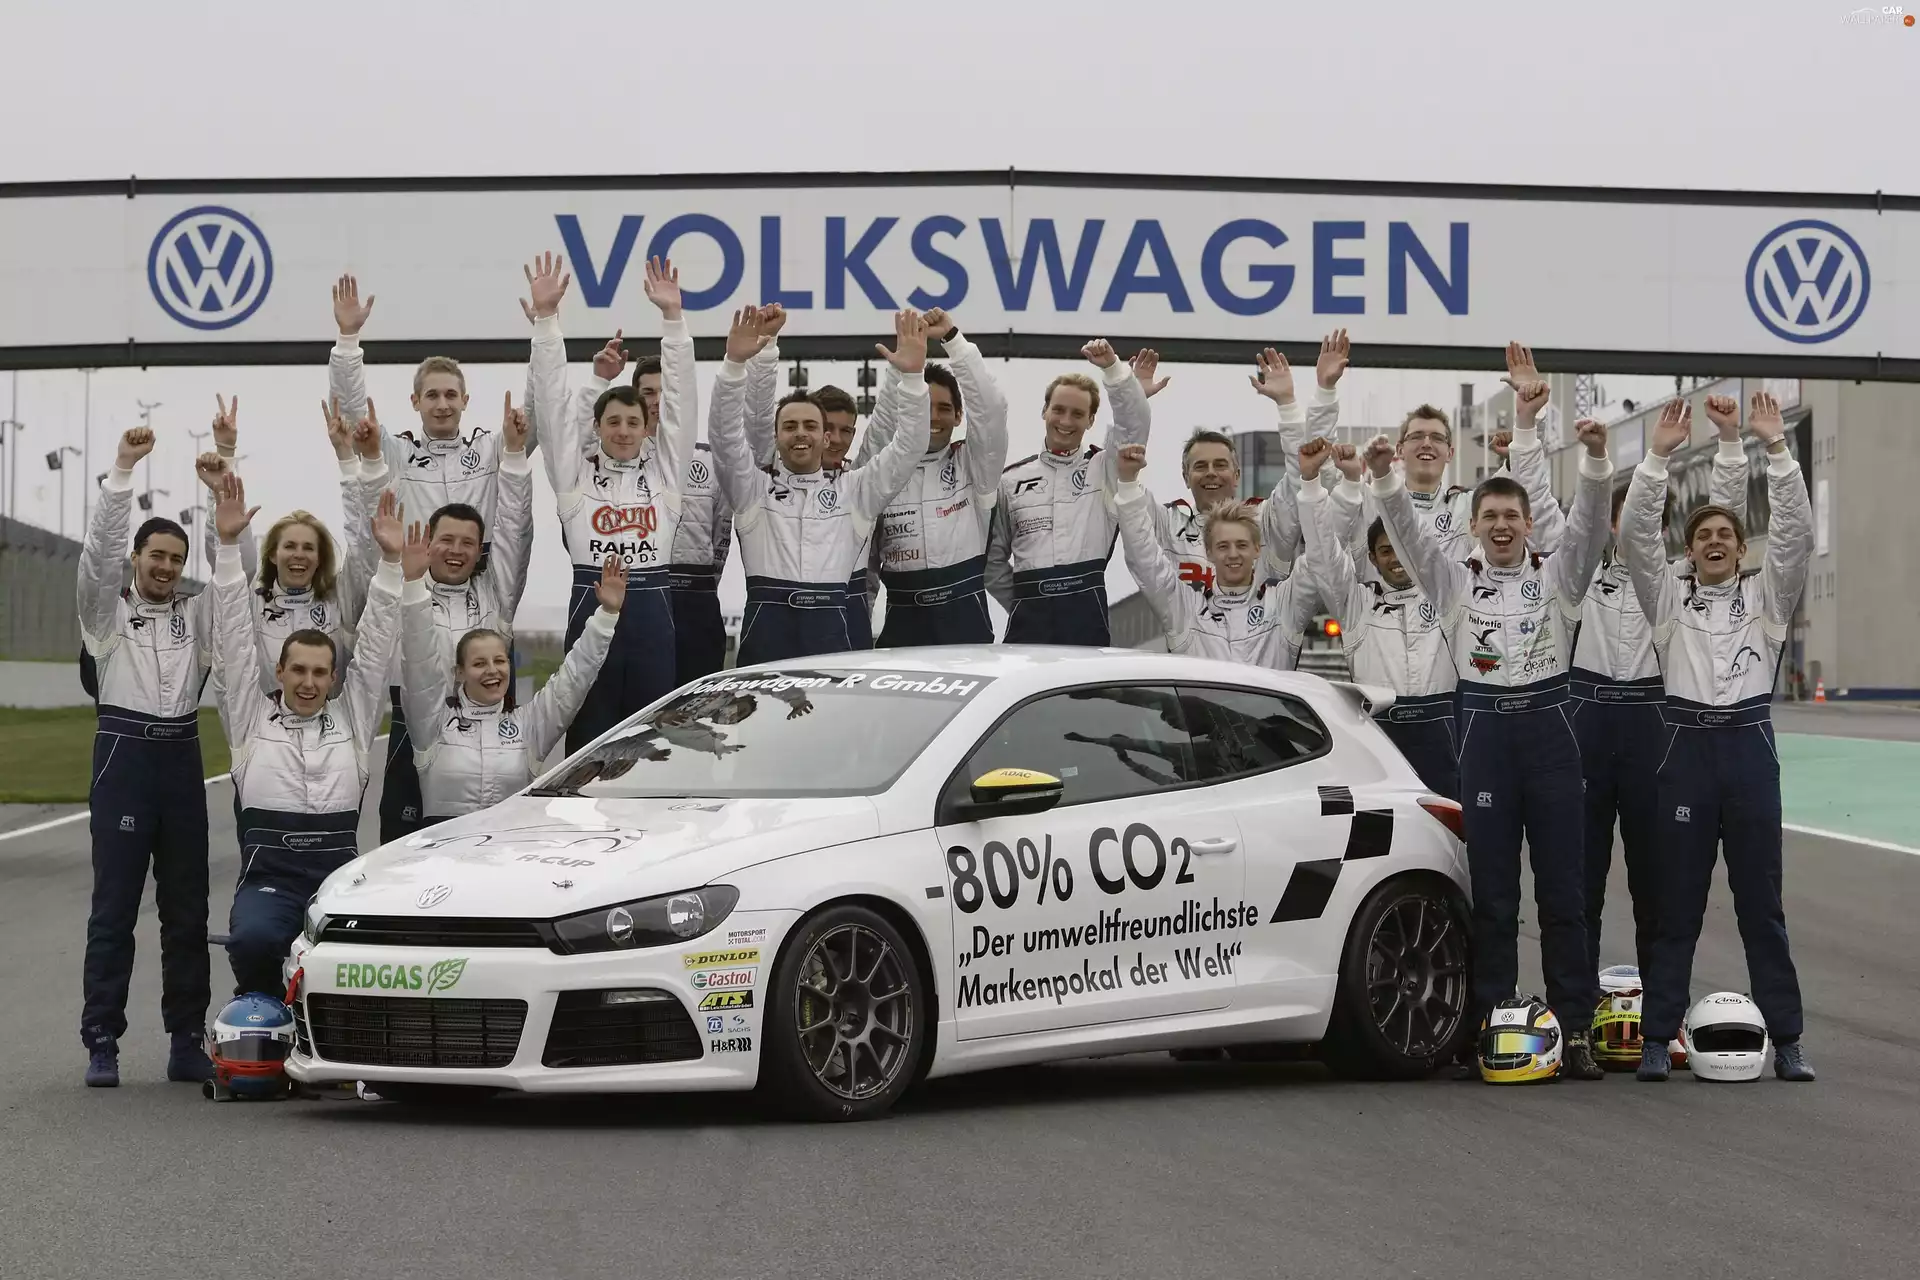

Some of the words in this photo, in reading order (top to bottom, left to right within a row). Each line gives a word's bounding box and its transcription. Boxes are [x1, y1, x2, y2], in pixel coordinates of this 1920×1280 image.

[554, 213, 1470, 317] VOLKSWAGEN
[589, 539, 658, 555] RAHAL
[1468, 613, 1502, 629] helvetia
[680, 675, 833, 697] Volkswagen
[836, 673, 867, 689] R
[869, 674, 979, 697] GmbH
[1000, 769, 1031, 780] ADAC
[925, 834, 1074, 914] -80%
[1024, 898, 1259, 948] umweltfreundlichste
[728, 928, 767, 939] MOTORSPORT
[698, 951, 758, 964] DUNLOP
[336, 963, 422, 990] ERDGAS
[708, 971, 752, 987] Castrol
[957, 956, 1123, 1009] Markenpokal
[1130, 952, 1169, 988] der
[700, 990, 748, 1007] ATS
[711, 1039, 737, 1053] H&R
